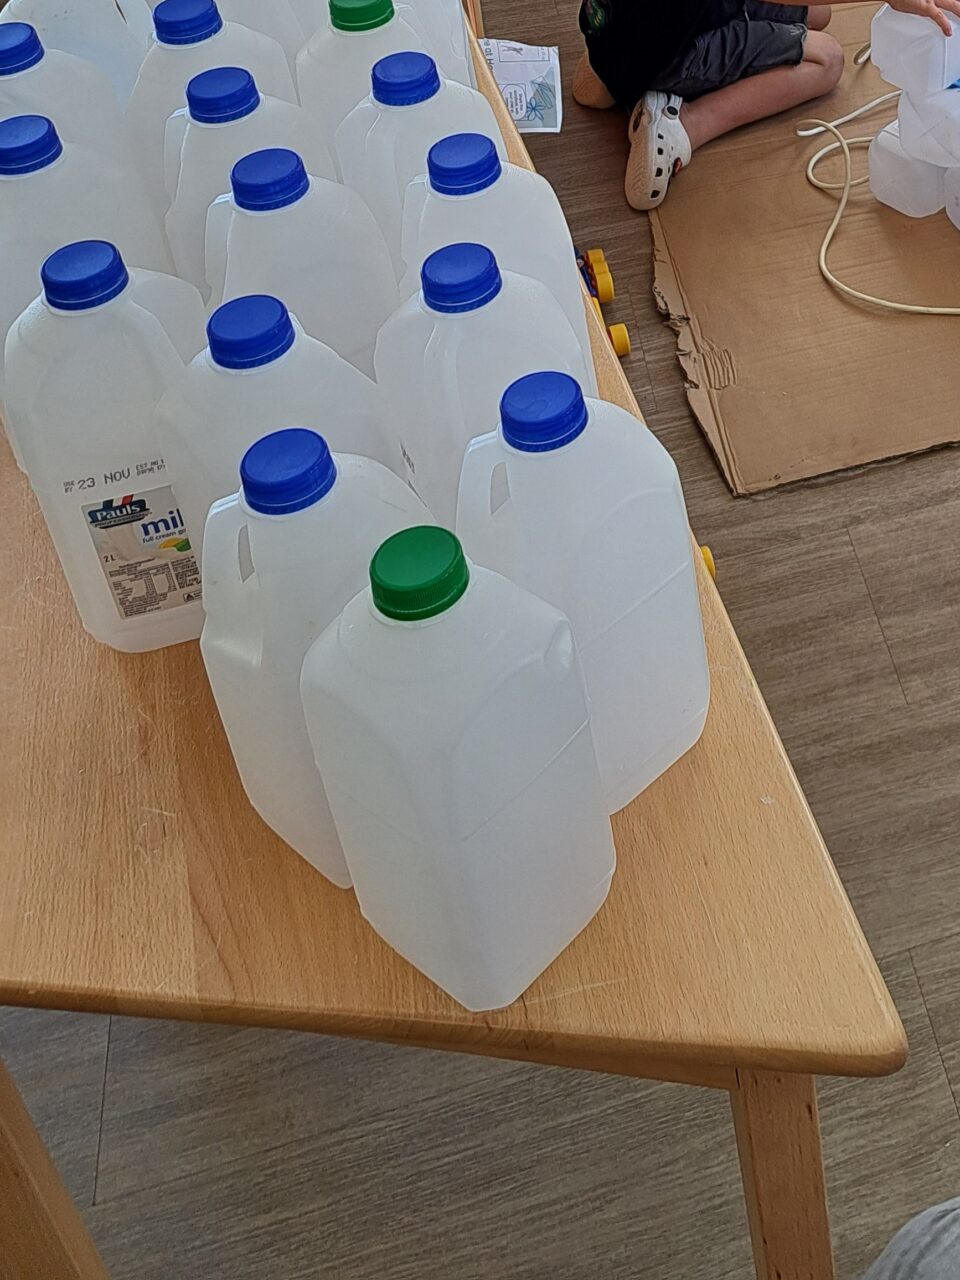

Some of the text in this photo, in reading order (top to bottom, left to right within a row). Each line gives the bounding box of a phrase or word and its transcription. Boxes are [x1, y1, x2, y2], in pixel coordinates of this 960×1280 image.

[485, 48, 493, 56] at
[486, 59, 494, 71] Ho
[77, 477, 96, 490] 23
[96, 503, 140, 521] Pauls
[140, 507, 184, 536] mil
[142, 535, 155, 543] full
[155, 531, 177, 541] cream
[103, 555, 110, 563] 2
